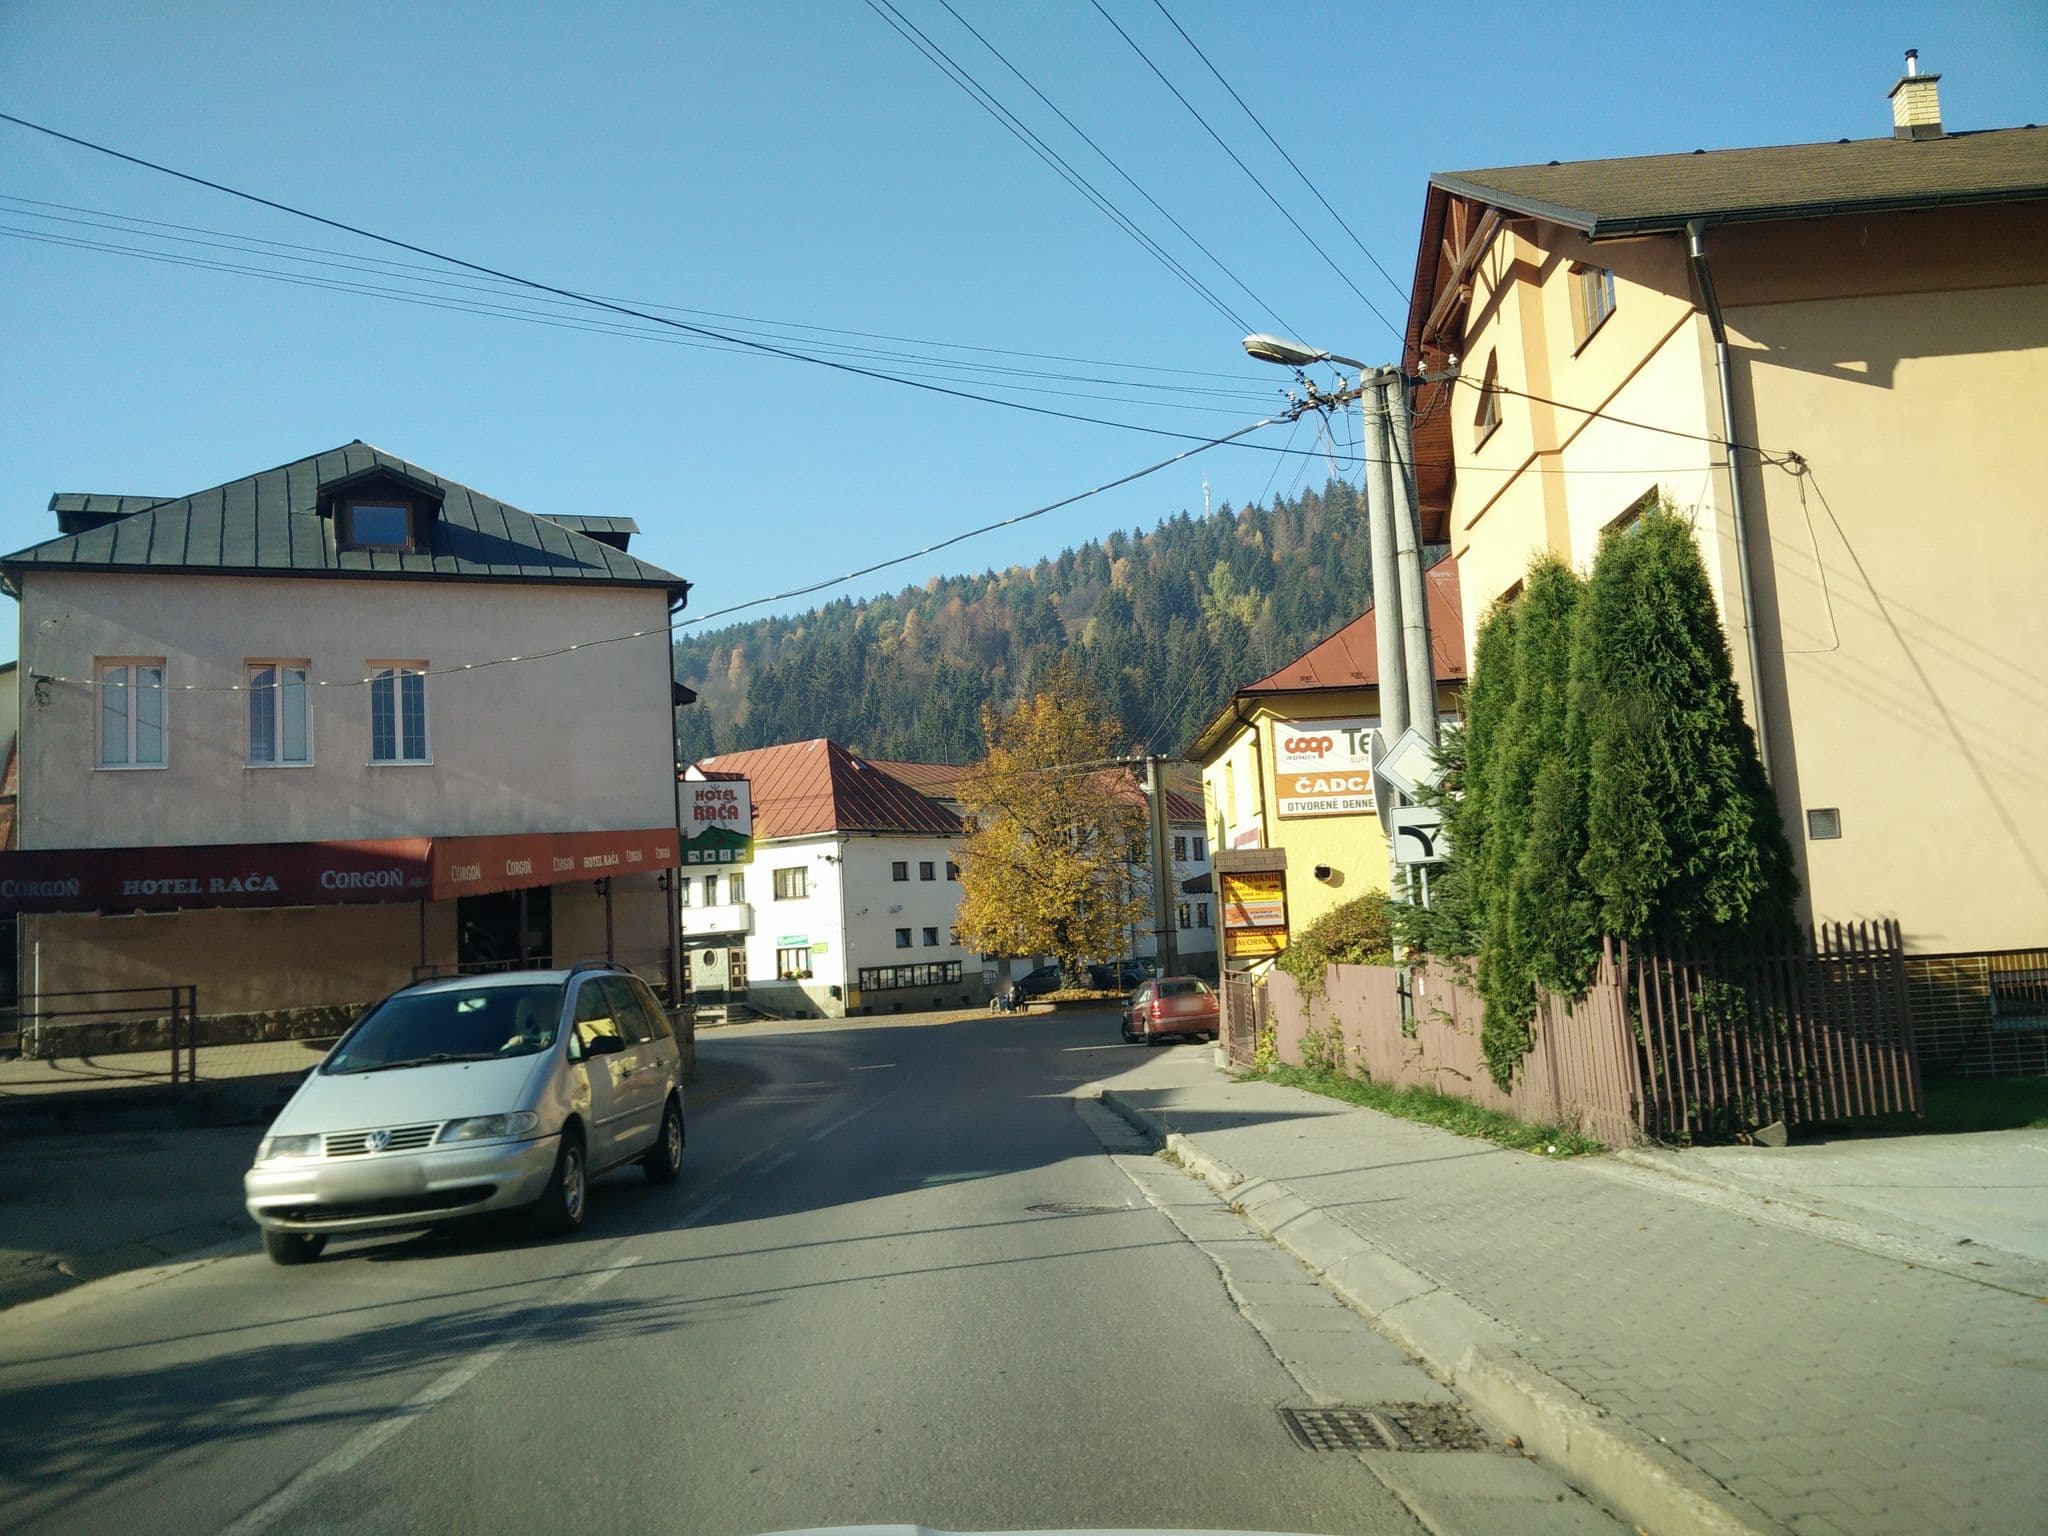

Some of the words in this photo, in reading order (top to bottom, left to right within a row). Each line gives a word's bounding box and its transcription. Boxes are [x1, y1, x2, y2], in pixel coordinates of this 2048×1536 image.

[1350, 756, 1369, 764] SUP
[695, 789, 738, 801] HOTEL
[693, 804, 739, 820] RAČA
[1287, 799, 1339, 812] OTVORENÉ
[1343, 798, 1375, 809] DENNE
[584, 855, 602, 869] HOTEL
[123, 878, 202, 896] HOTEL
[208, 873, 279, 894] RAČA
